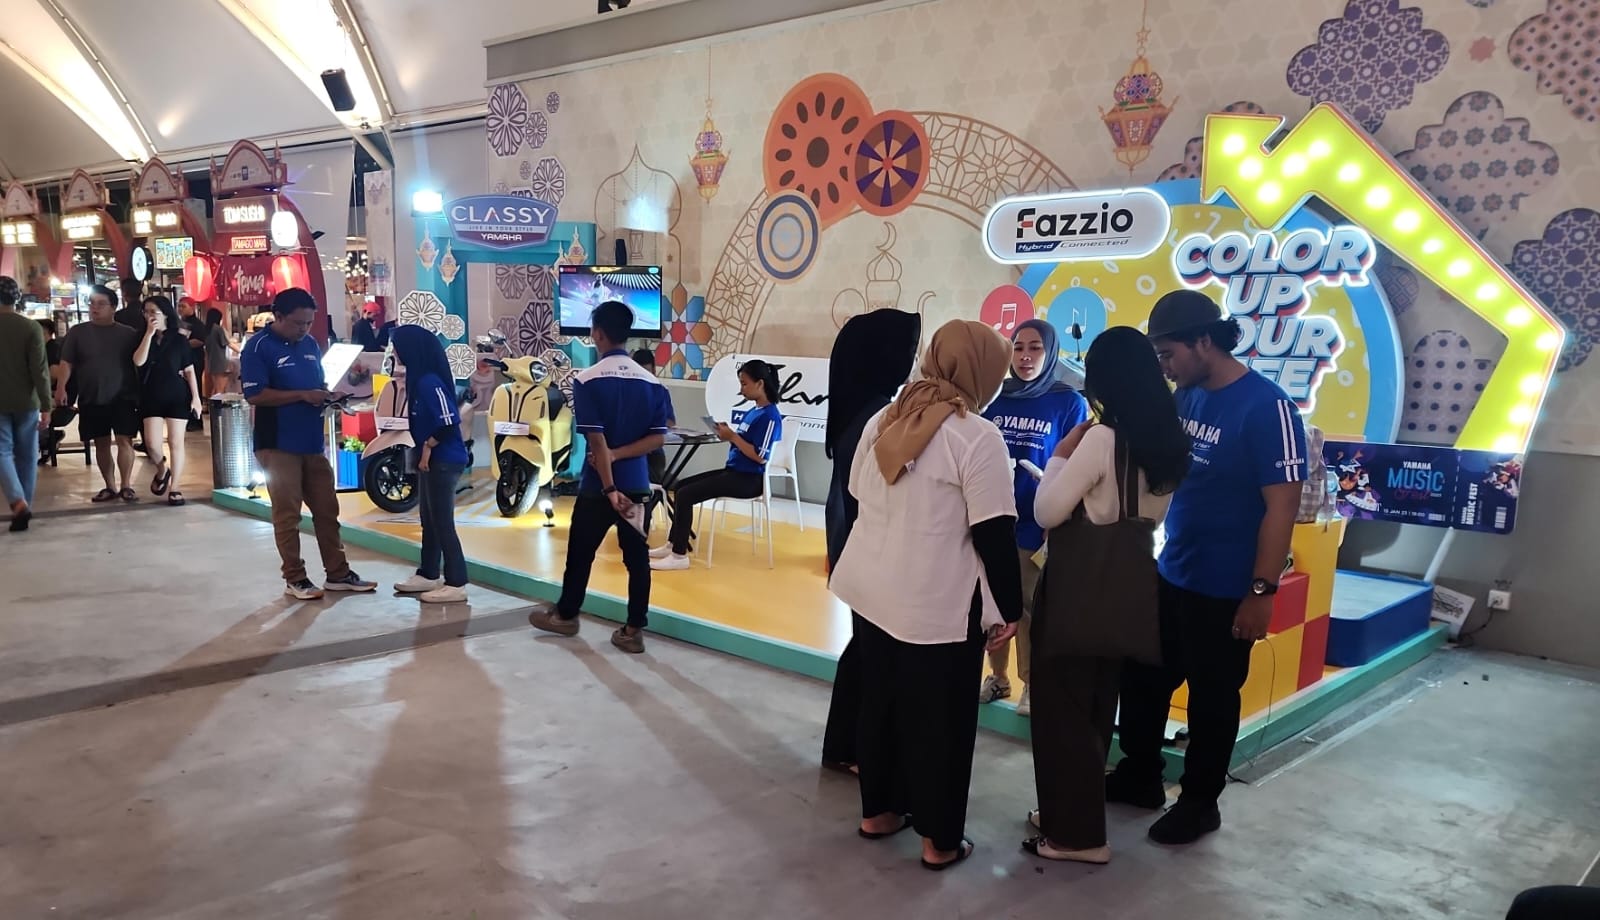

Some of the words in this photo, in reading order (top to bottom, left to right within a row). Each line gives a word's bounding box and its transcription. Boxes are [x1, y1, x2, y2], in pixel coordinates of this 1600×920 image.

[451, 205, 549, 224] CLASSY
[1016, 202, 1133, 238] Fazzio
[481, 233, 522, 241] YAMAHA
[1018, 242, 1054, 252] Hybrid
[1061, 239, 1129, 248] Connected
[1176, 230, 1369, 277] COLOR
[1226, 274, 1304, 316] UP
[1003, 415, 1052, 435] YAMAHA
[1403, 461, 1432, 470] YAMAHA
[1388, 467, 1443, 492] MUSIC
[1469, 483, 1478, 499] FEST
[1466, 500, 1476, 525] MUSIC
